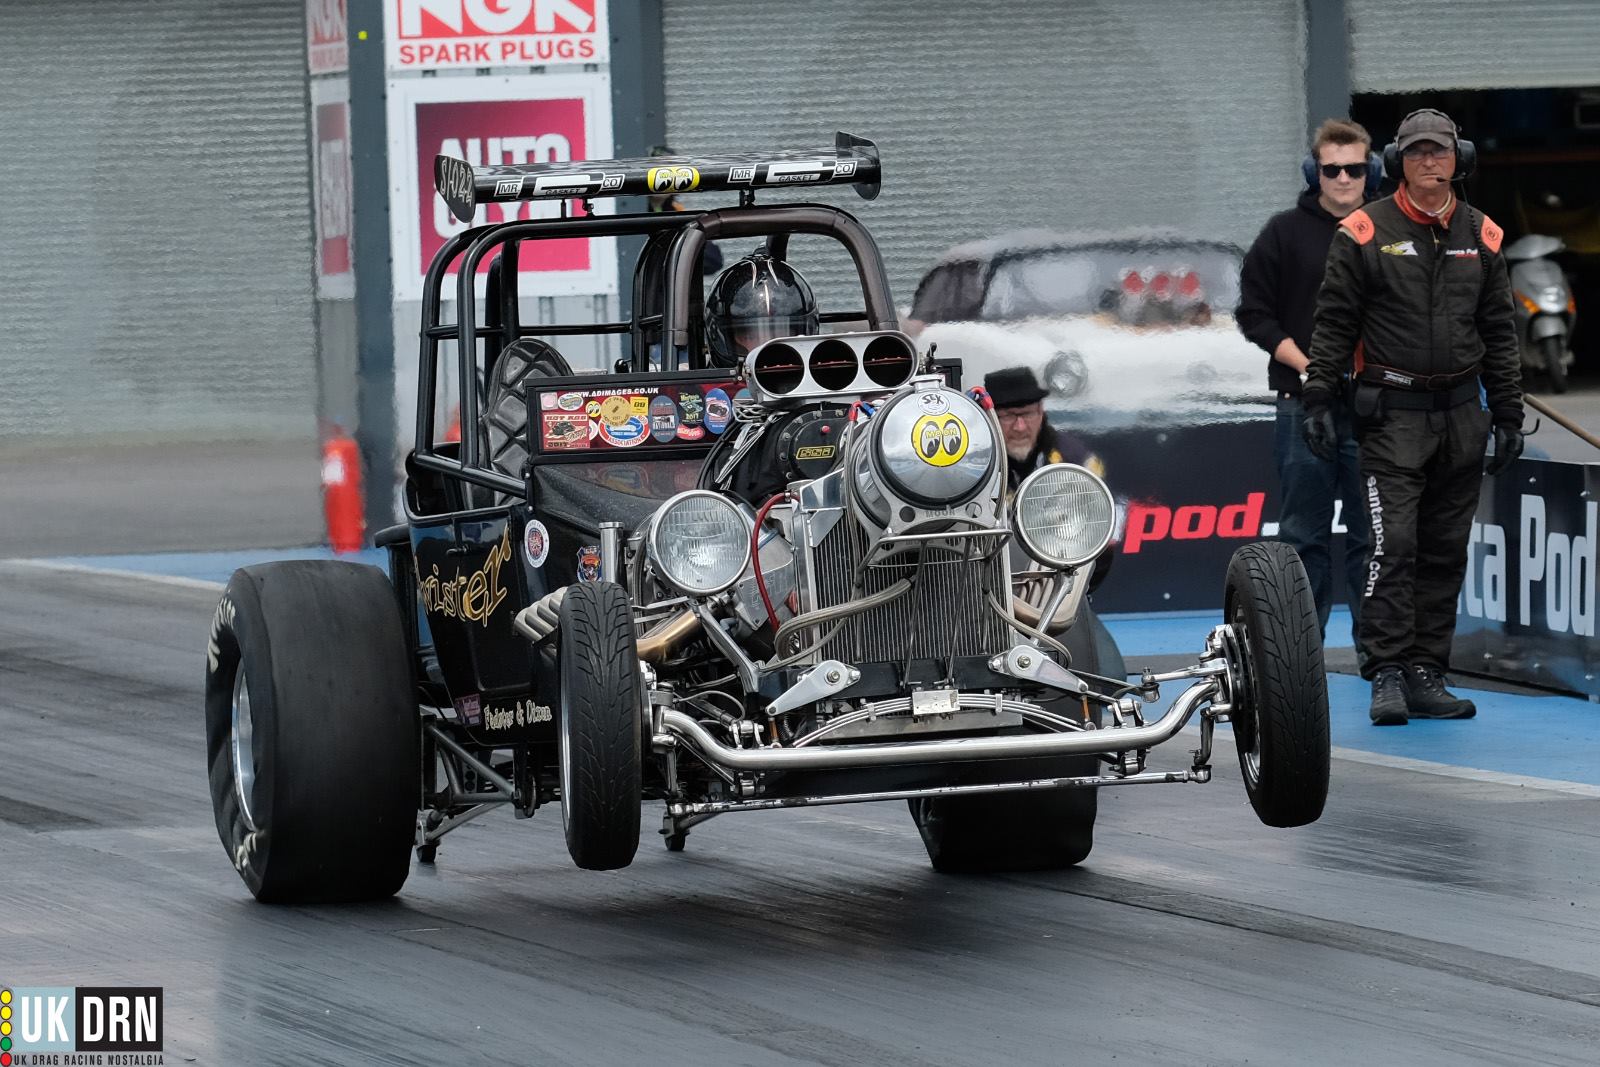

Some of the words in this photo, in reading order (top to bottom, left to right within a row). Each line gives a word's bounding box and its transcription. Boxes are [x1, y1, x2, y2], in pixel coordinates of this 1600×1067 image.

[401, 0, 594, 37] NGK
[400, 43, 491, 65] SPARK
[501, 39, 595, 61] PLUGS
[925, 428, 957, 439] MOON
[1520, 494, 1598, 637] Pod
